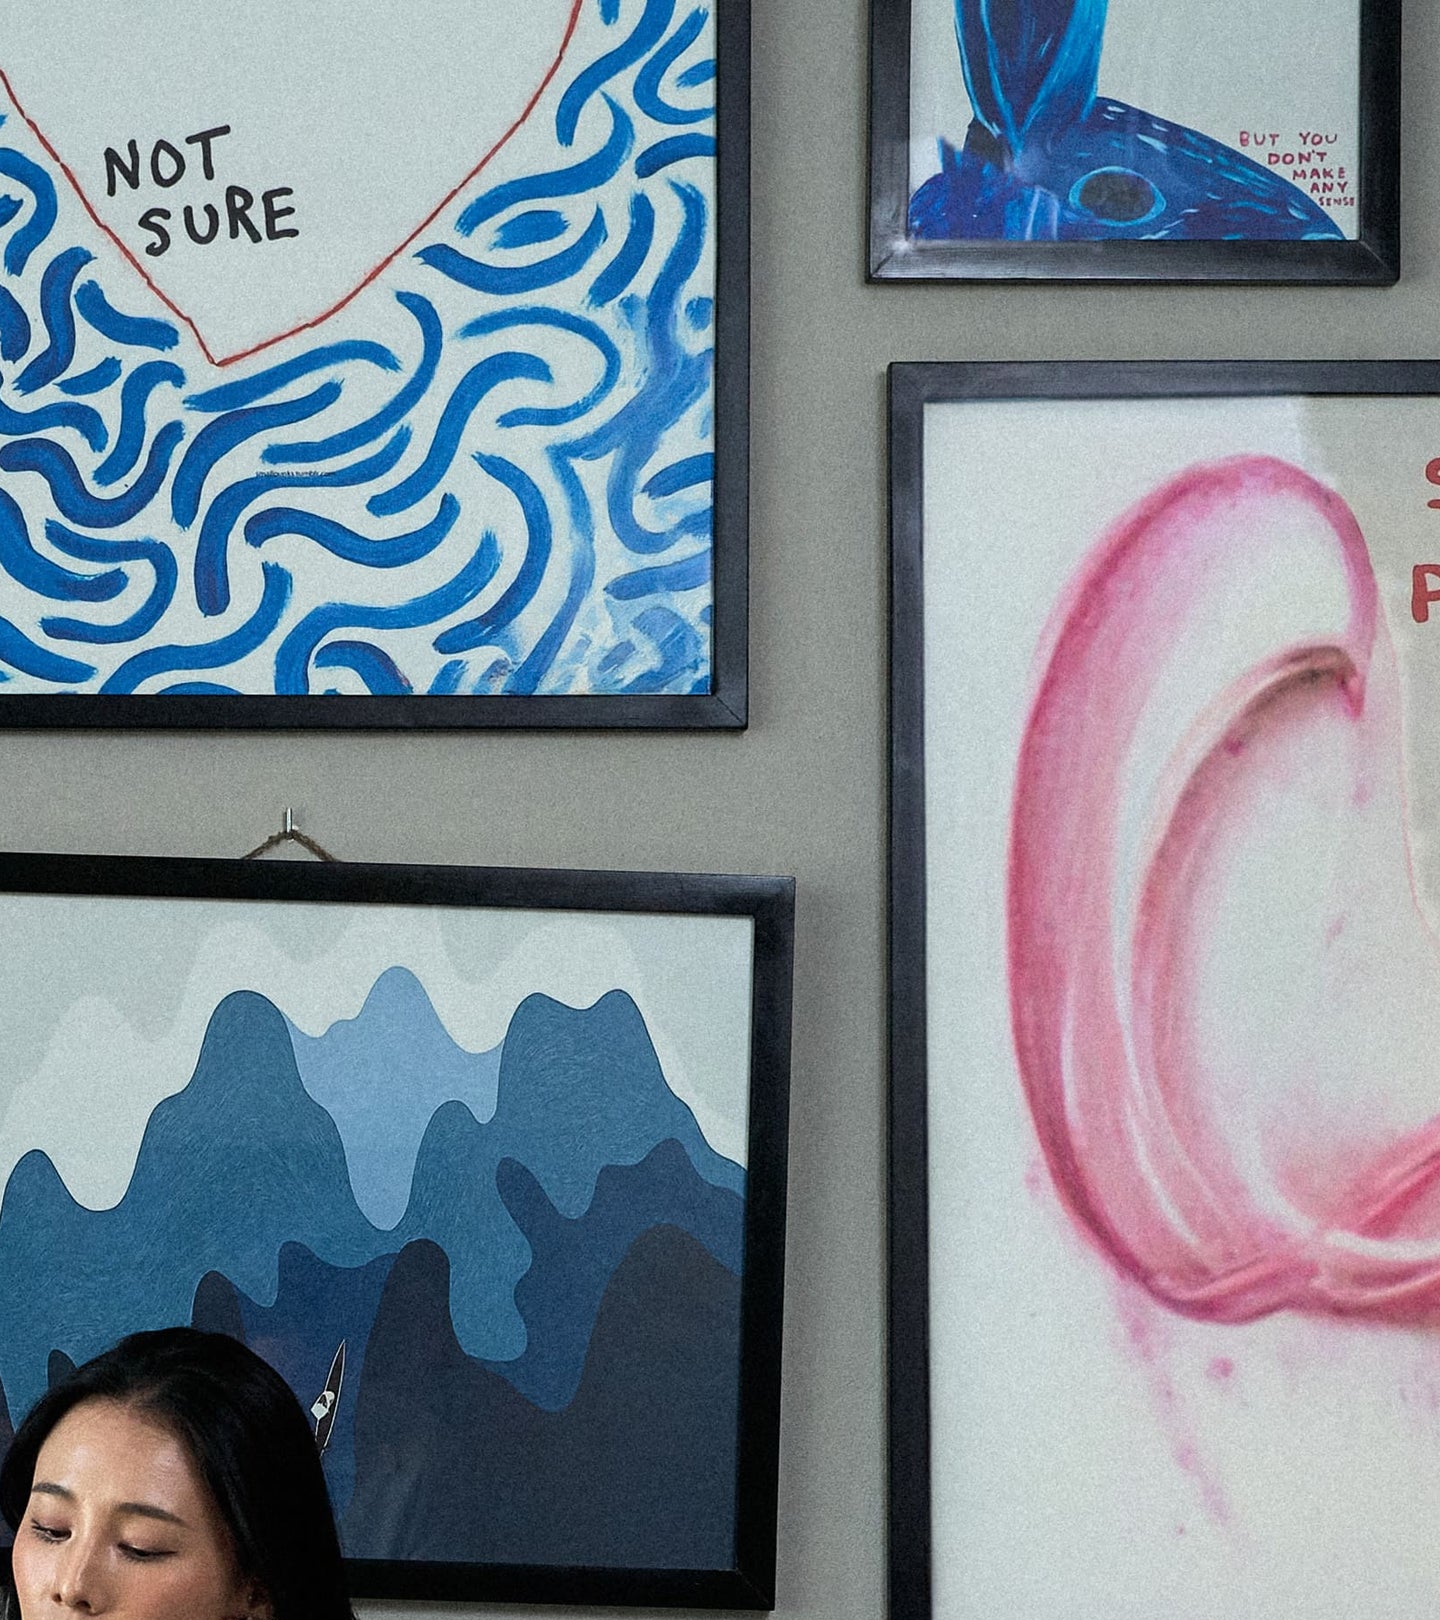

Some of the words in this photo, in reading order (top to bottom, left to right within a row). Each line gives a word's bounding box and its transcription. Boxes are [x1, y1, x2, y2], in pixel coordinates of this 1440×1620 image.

[1239, 131, 1280, 147] BUT
[1299, 131, 1338, 146] YOU
[104, 125, 231, 197] NOT
[1268, 149, 1327, 165] DON'T
[1293, 167, 1346, 180] MAKE
[1310, 181, 1348, 193] ANY
[1319, 196, 1355, 206] SENSE
[138, 185, 299, 257] SURE
